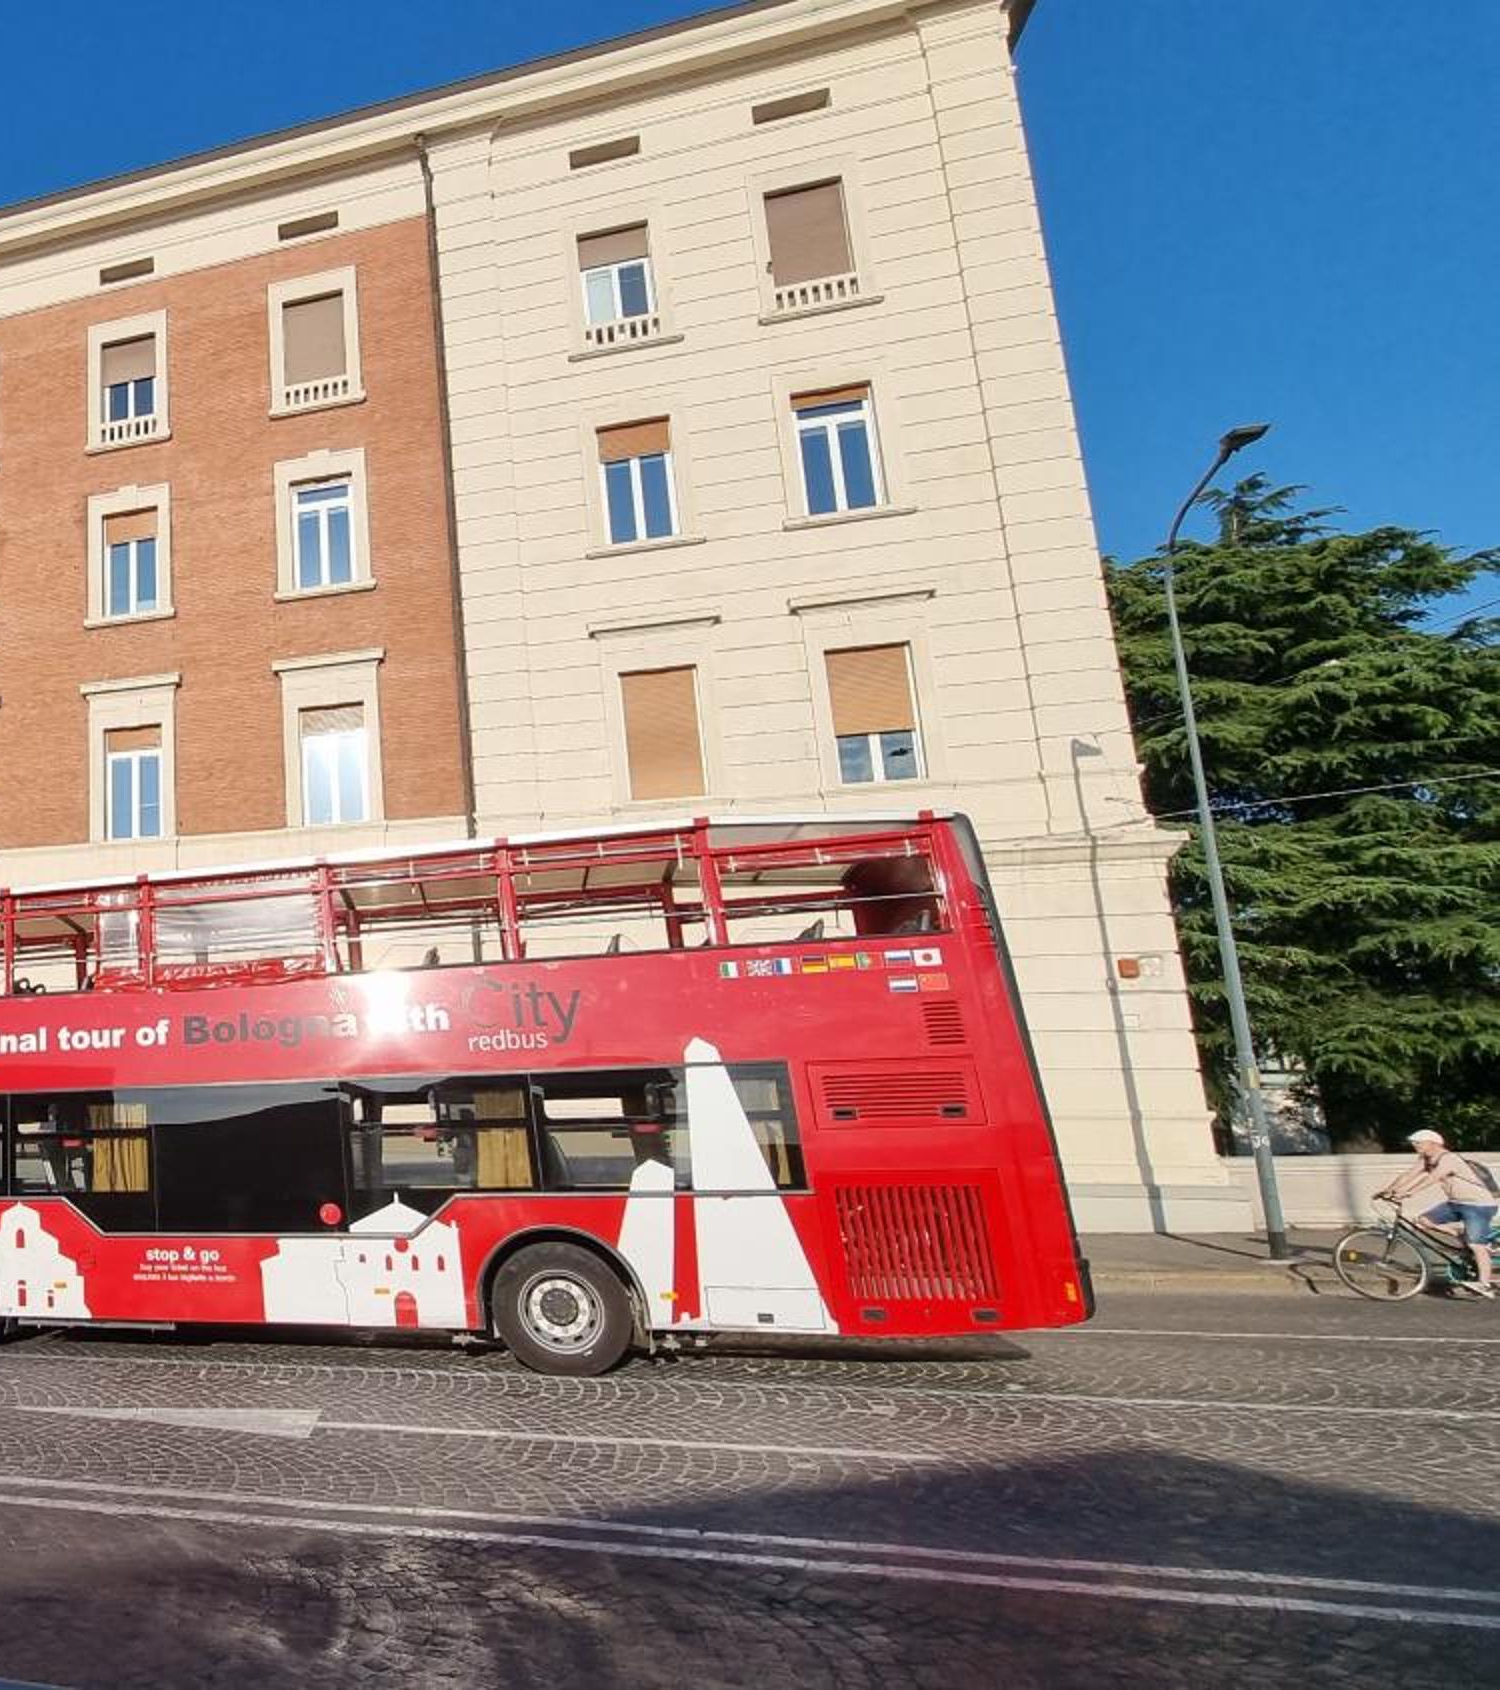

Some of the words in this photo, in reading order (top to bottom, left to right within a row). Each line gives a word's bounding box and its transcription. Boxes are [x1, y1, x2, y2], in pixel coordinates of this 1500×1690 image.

[464, 975, 581, 1043] City
[58, 1024, 124, 1050] tour
[135, 1019, 170, 1047] of
[183, 1012, 358, 1046] Bologna
[467, 1029, 549, 1052] redbus
[146, 1248, 179, 1264] stop
[183, 1246, 197, 1261] &
[200, 1250, 219, 1265] go
